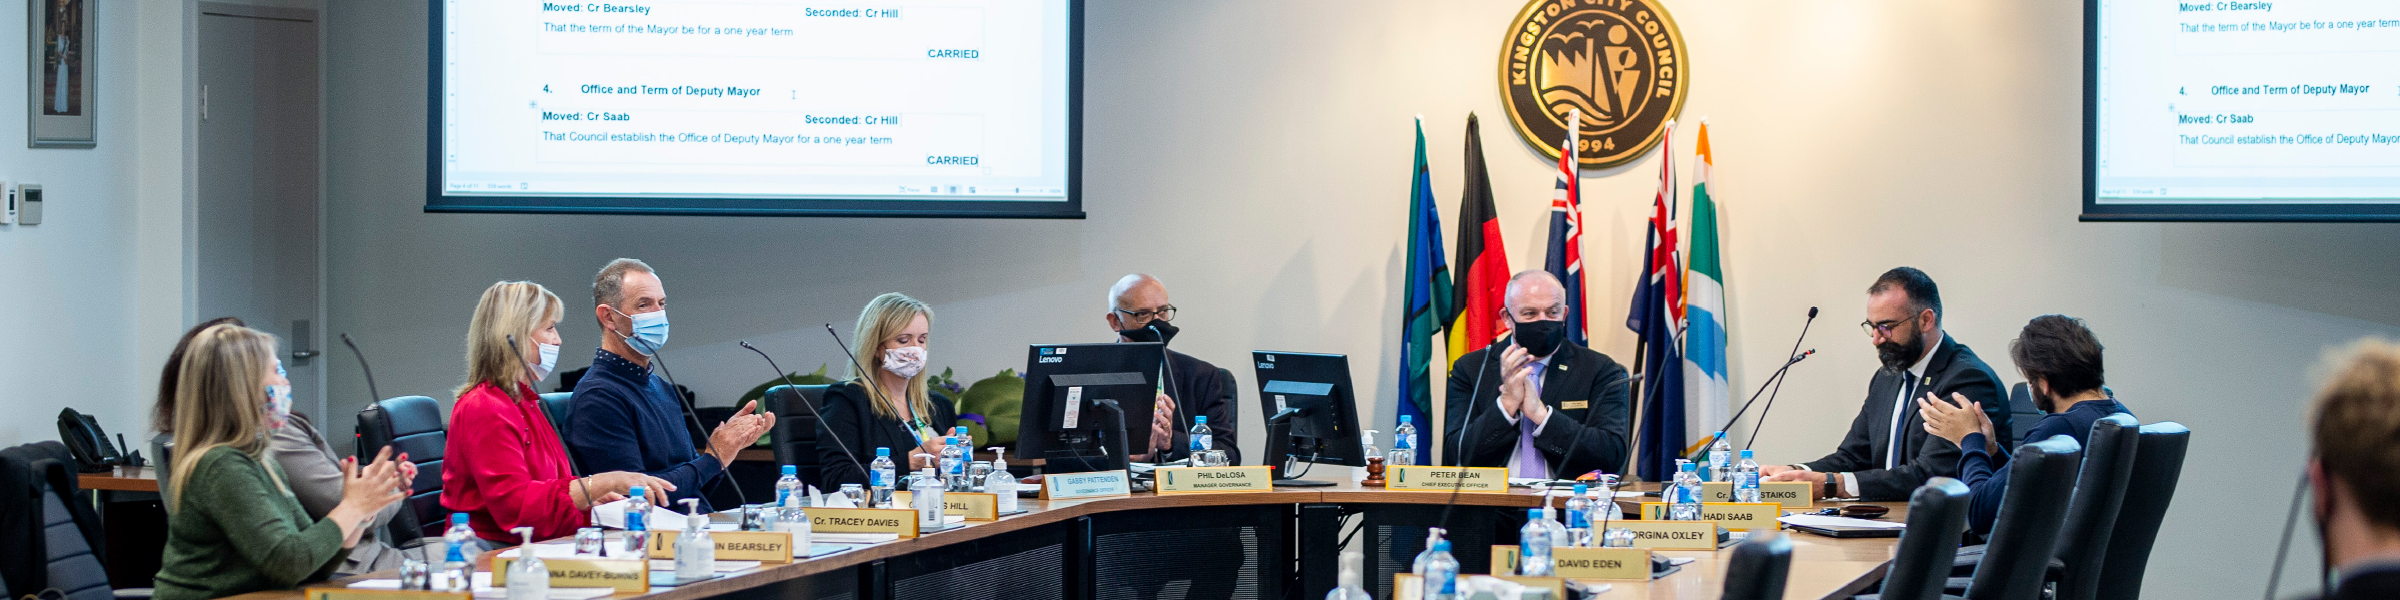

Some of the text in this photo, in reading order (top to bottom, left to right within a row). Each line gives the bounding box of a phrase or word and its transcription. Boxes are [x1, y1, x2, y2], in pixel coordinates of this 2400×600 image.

[543, 2, 651, 16] Moved: Cr Bearsley
[2180, 0, 2273, 13] Moved: Cr Bearsley
[805, 7, 899, 19] Seconded: Cr Hill
[543, 21, 794, 39] That the term of the Mayor be for a one year term
[2180, 18, 2400, 33] That the term of the Mayor be for a one year term
[928, 48, 979, 59] CARRIED
[1512, 0, 1674, 98] KINGSTON COUNCIL
[542, 83, 761, 99] 4. Office and Term of Deputy Mayor
[2178, 82, 2371, 97] 4. Office and Term of Deputy Mayor
[542, 111, 630, 122] Moved: Cr Saab
[804, 114, 898, 125] Seconded: Cr Hill
[2179, 113, 2254, 124] Moved: Cr Saab
[543, 130, 893, 147] That Council establish the Office of Deputy Mayor for a one year term
[2179, 134, 2199, 145] That
[2201, 134, 2235, 145] Council
[2236, 134, 2277, 145] establish
[2279, 134, 2294, 145] the
[2296, 133, 2324, 145] Office
[2325, 133, 2335, 144] of
[2336, 133, 2370, 146] Deputy
[1578, 136, 1616, 153] 994
[927, 155, 979, 166] CARRIED
[1039, 355, 1063, 363] Lenovo
[1216, 471, 1246, 479] DeLOSA
[1430, 471, 1481, 479] PETER BEAN
[1716, 491, 1797, 499] Cr. STAIKOS
[949, 502, 969, 510] HILL
[814, 516, 899, 527] Cr. TRACEY DAVIES
[1703, 513, 1753, 521] HADI SAAB
[1631, 530, 1705, 540] ORGINA OXLEY
[727, 542, 782, 551] BEARSLEY
[1558, 559, 1622, 569] DAVID EDEN
